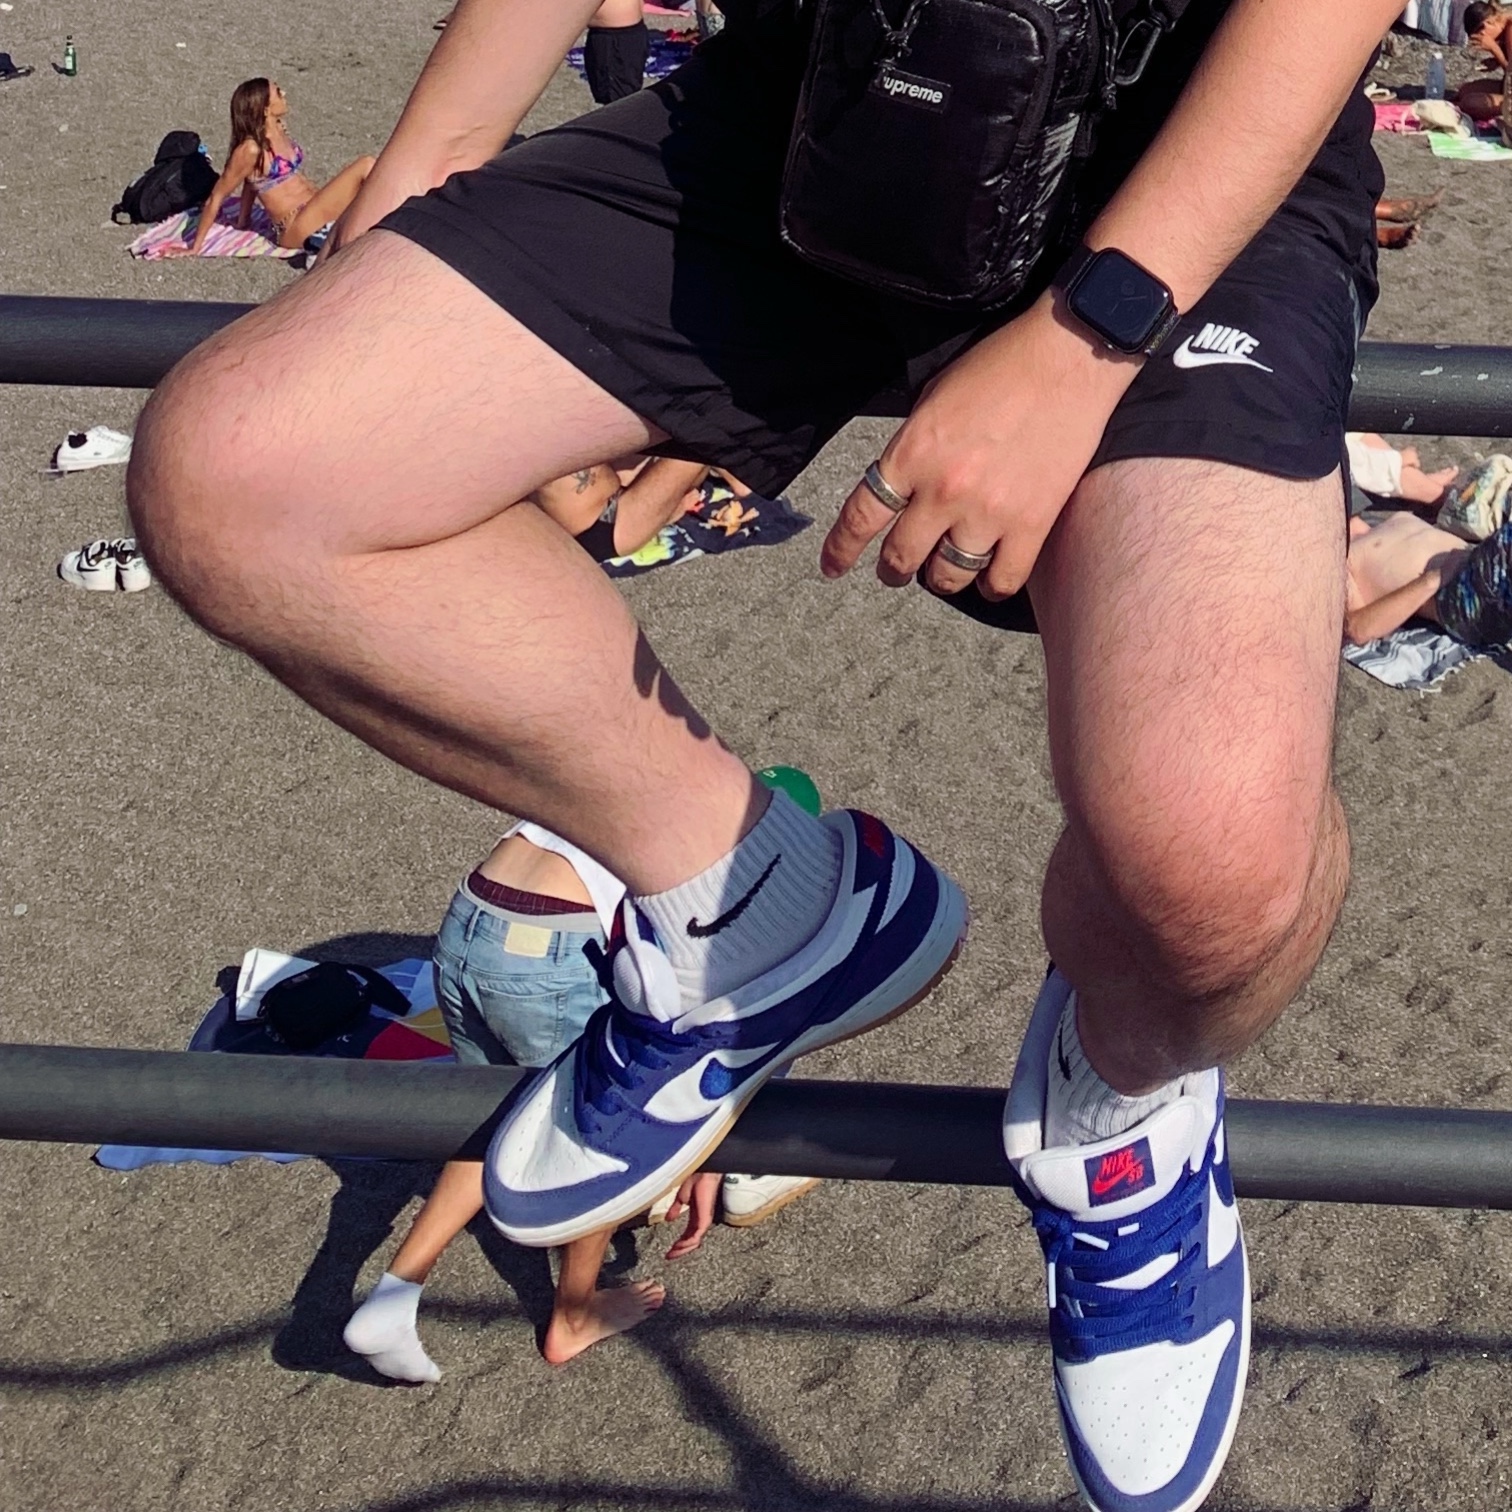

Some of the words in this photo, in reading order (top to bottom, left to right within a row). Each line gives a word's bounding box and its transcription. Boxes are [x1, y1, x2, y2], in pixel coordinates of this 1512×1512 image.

[883, 76, 943, 103] upreme
[1191, 322, 1260, 359] NIKE
[1102, 1147, 1135, 1176] NIKE
